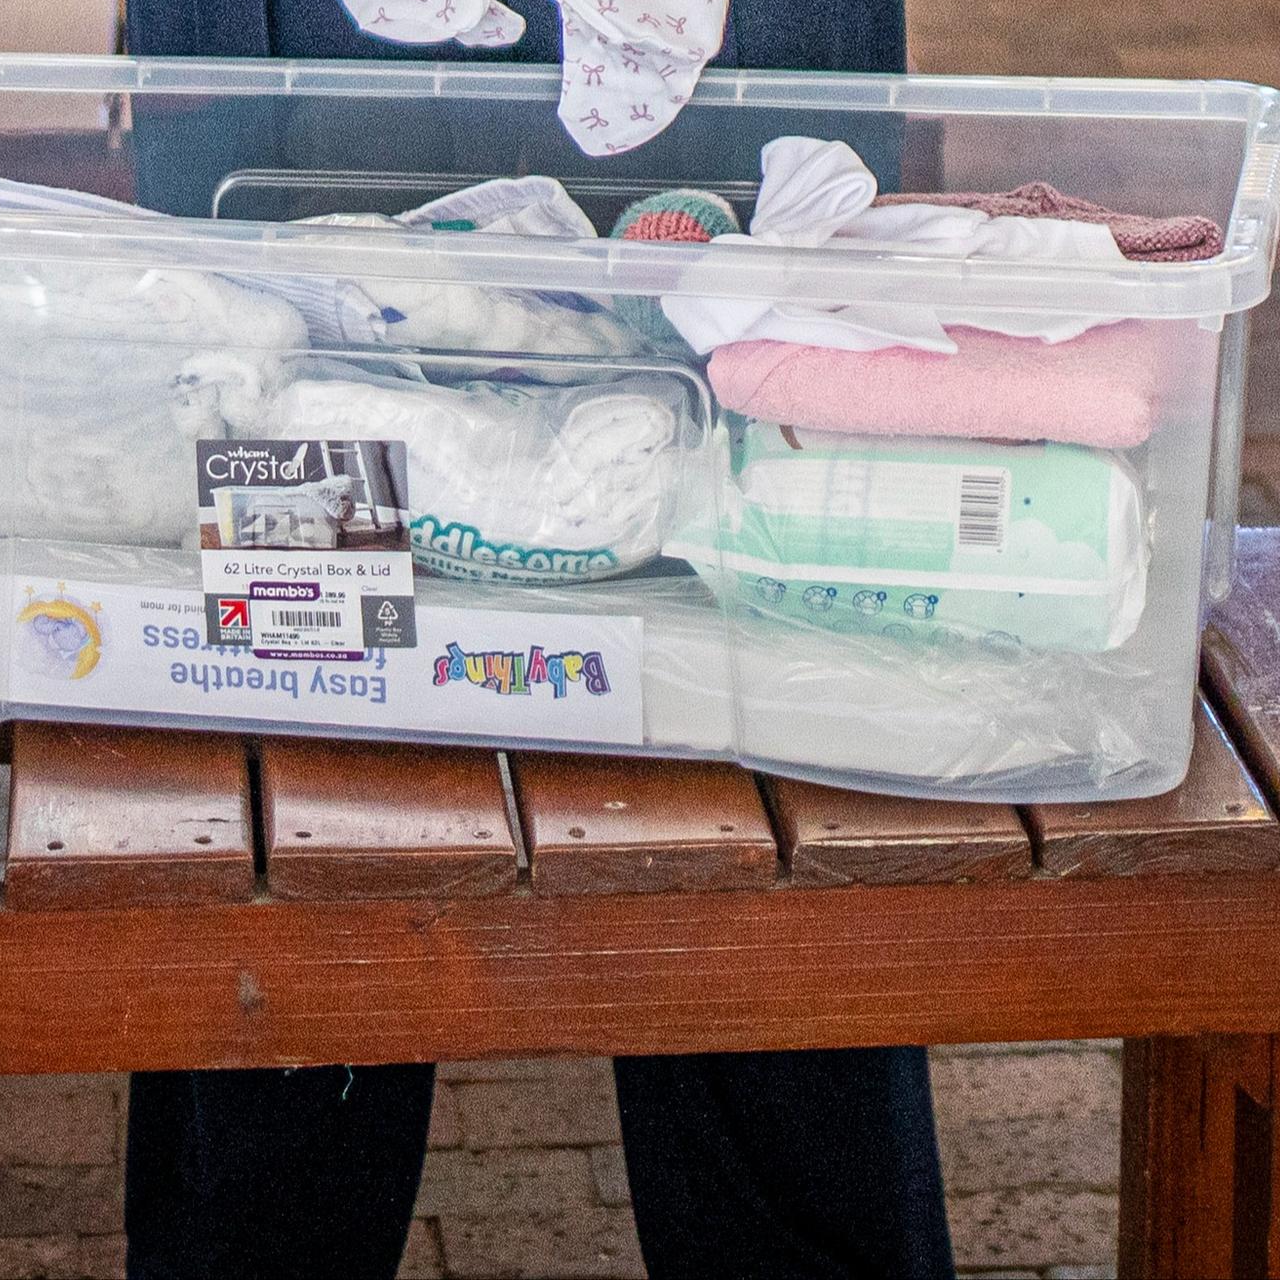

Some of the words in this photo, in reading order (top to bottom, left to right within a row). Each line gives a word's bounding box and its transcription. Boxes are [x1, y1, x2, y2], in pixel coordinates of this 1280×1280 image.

[206, 453, 306, 486] Crystal
[223, 564, 240, 575] 62
[243, 563, 274, 576] Litre
[277, 564, 323, 579] Crystal
[327, 564, 353, 577] Box
[356, 565, 367, 576] &
[371, 564, 391, 577] Lid
[140, 600, 166, 611] mom
[167, 600, 180, 612] for
[170, 662, 299, 699] breathe
[309, 665, 387, 703] Easy
[433, 641, 612, 699] BabyThings
